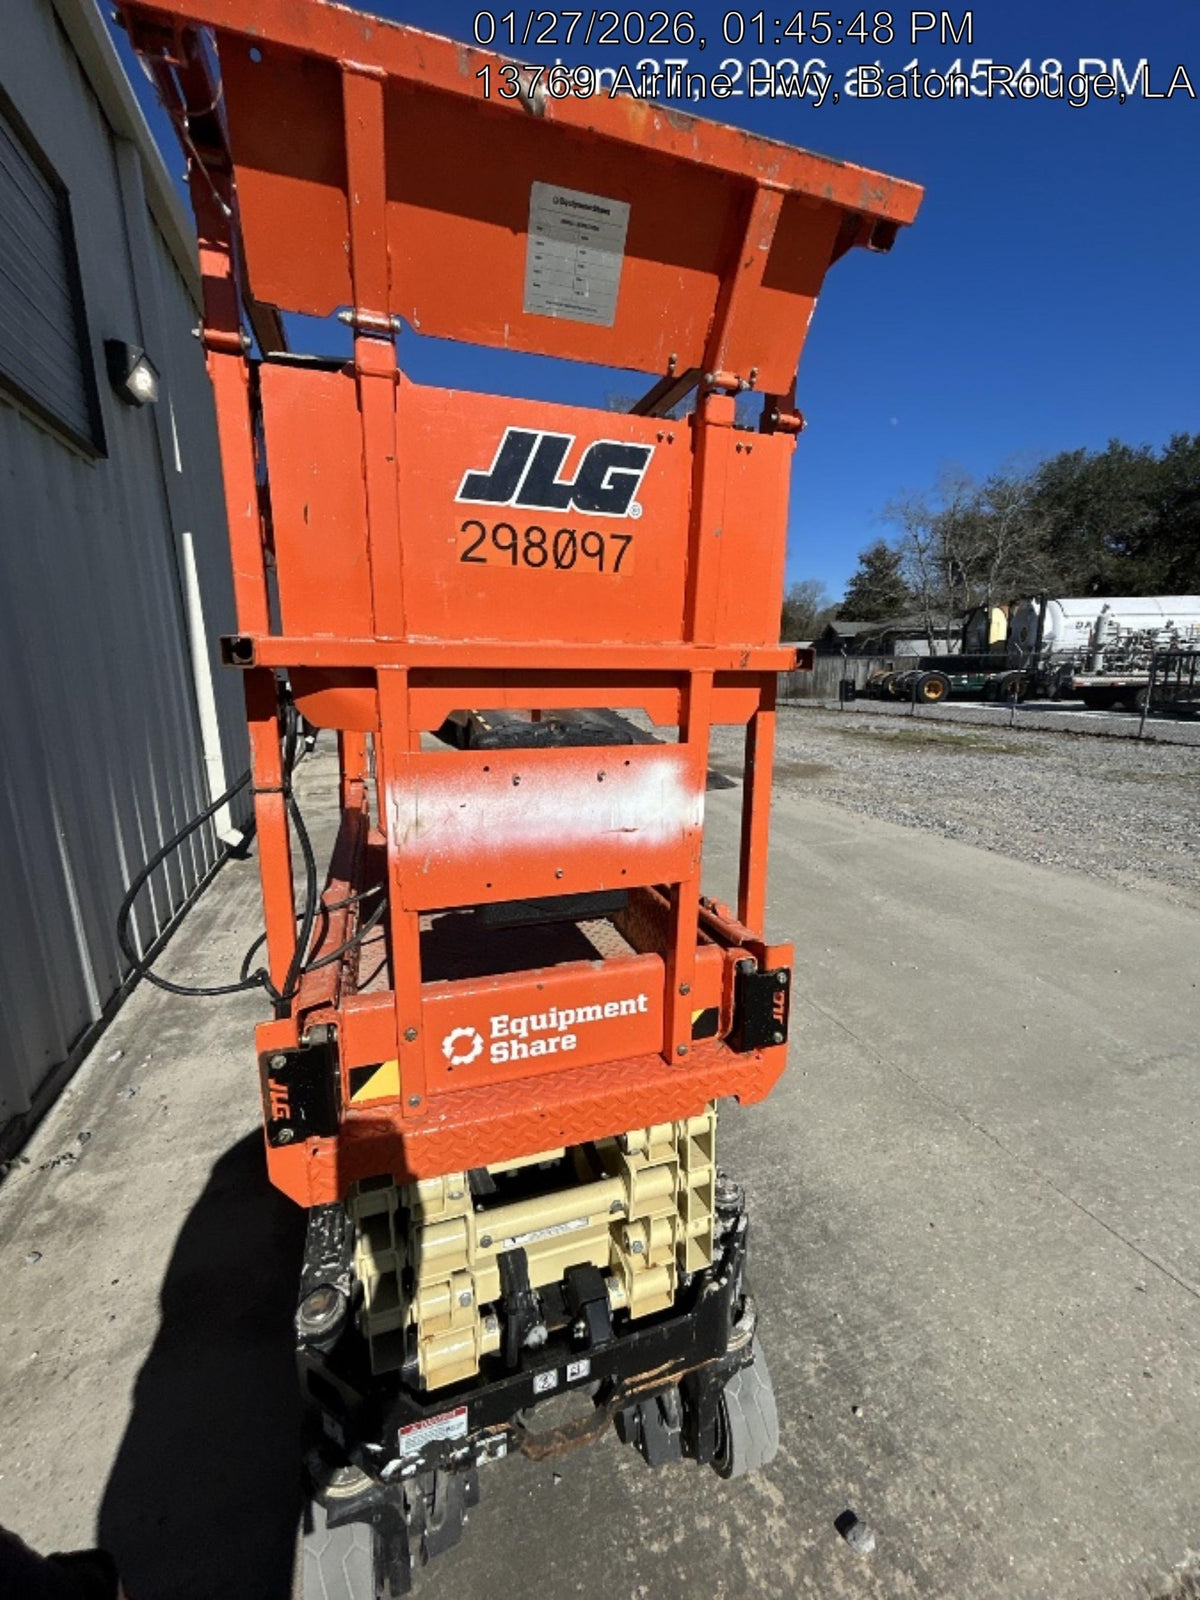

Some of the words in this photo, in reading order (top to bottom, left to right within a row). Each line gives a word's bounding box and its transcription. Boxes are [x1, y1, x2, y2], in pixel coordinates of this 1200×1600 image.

[455, 426, 655, 518] JLG
[460, 519, 633, 572] 298097
[489, 993, 648, 1038] Equipment
[773, 990, 785, 1025] JLG
[490, 1033, 577, 1064] Share
[268, 1079, 291, 1121] JLG
